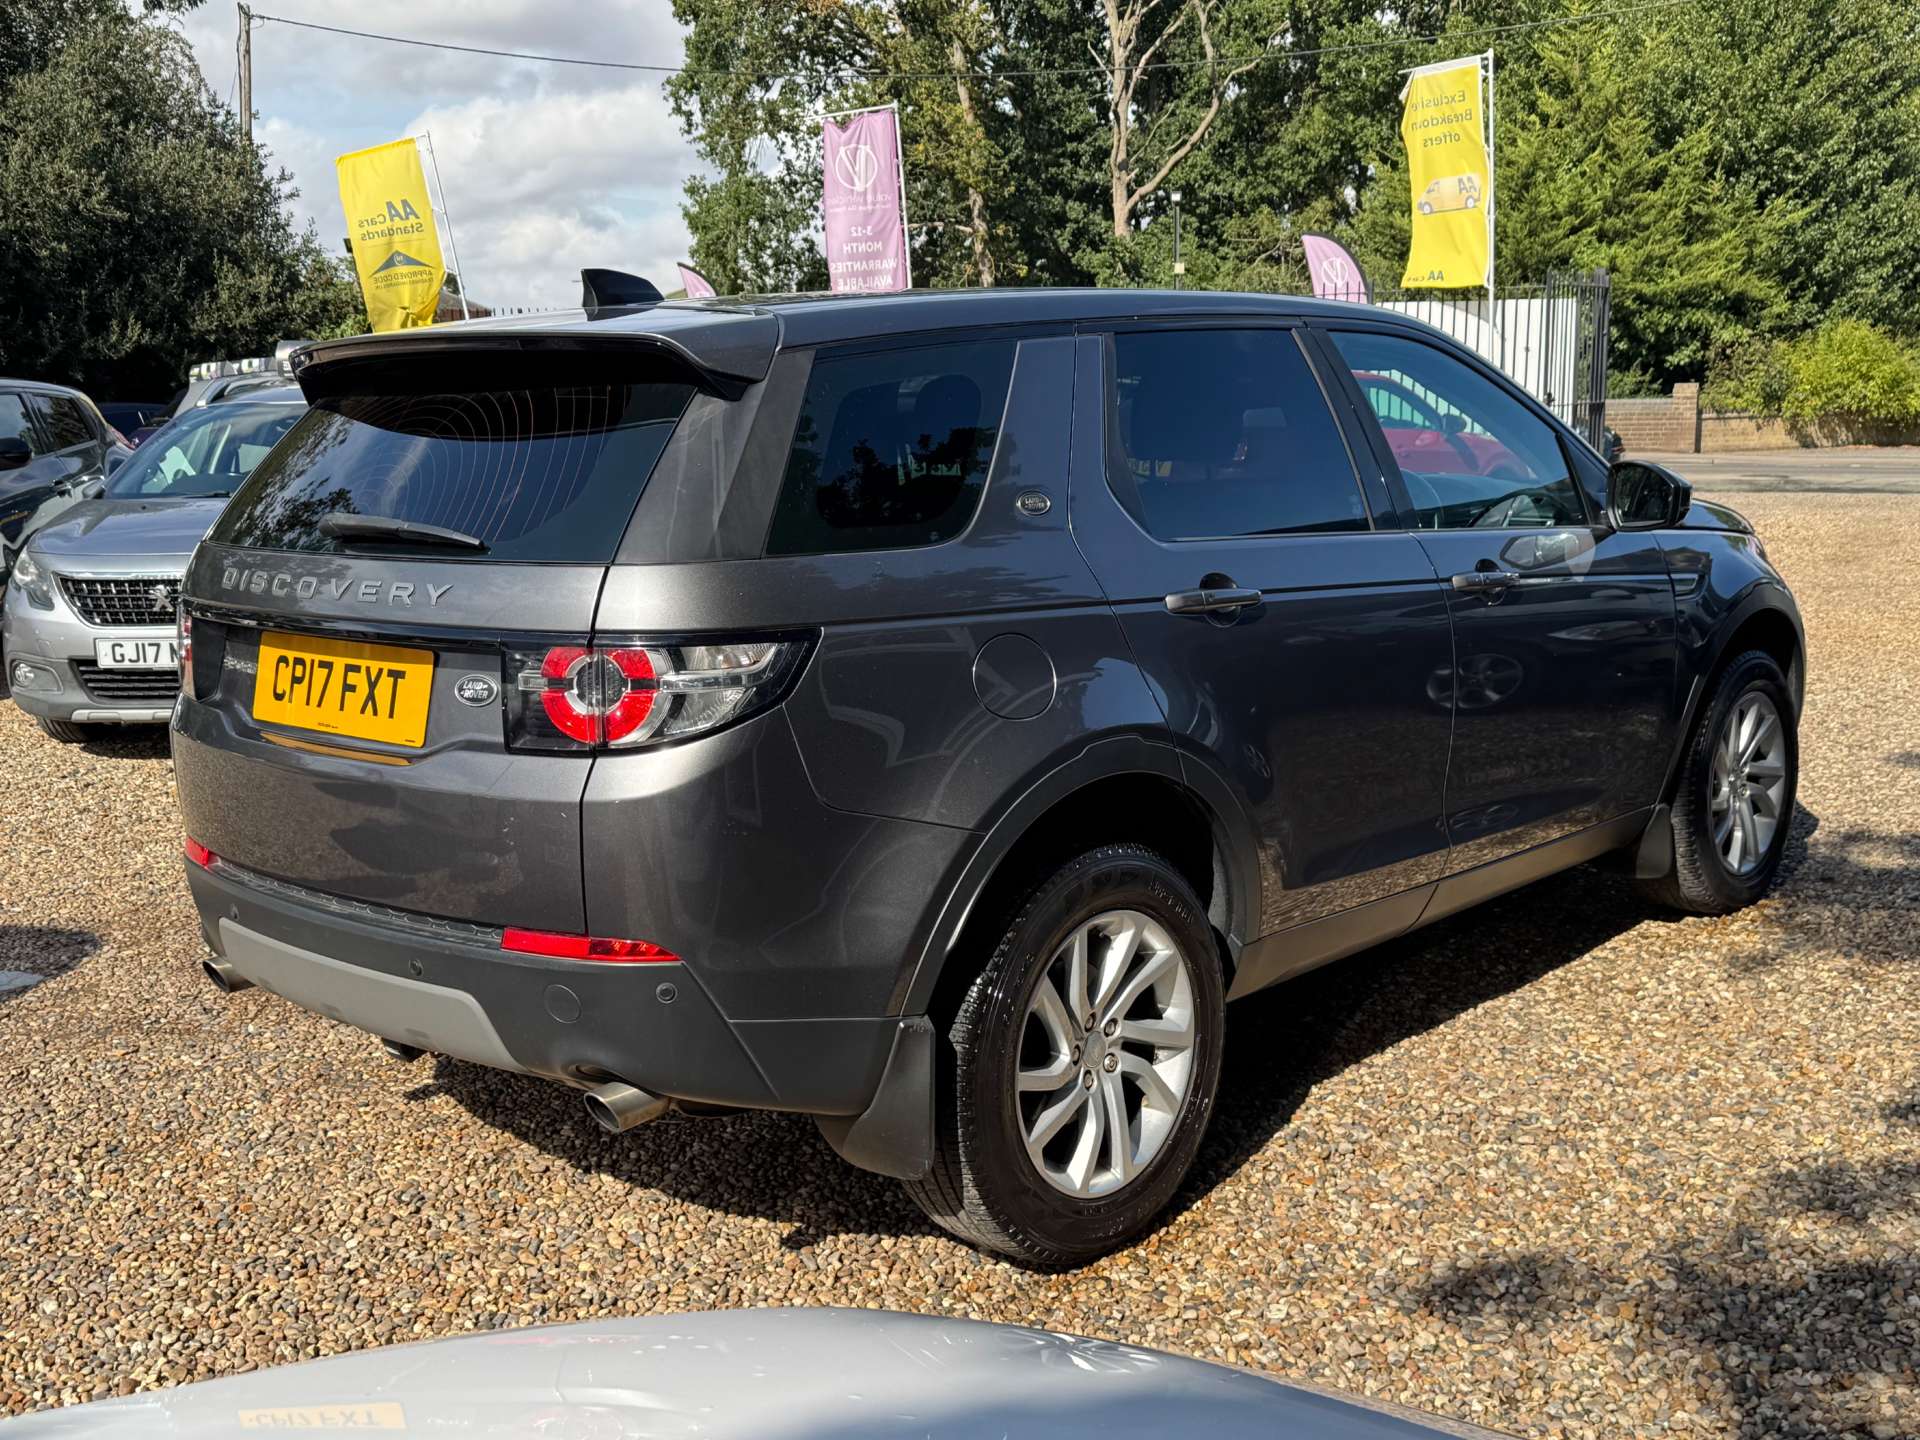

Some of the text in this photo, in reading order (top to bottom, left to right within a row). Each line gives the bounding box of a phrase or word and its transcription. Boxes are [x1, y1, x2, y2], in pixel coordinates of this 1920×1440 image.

[221, 567, 454, 608] DISCOVERY
[111, 643, 161, 663] GJ17
[272, 655, 407, 719] CP17 FXT
[463, 680, 484, 690] LAND
[463, 689, 489, 699] ROVER
